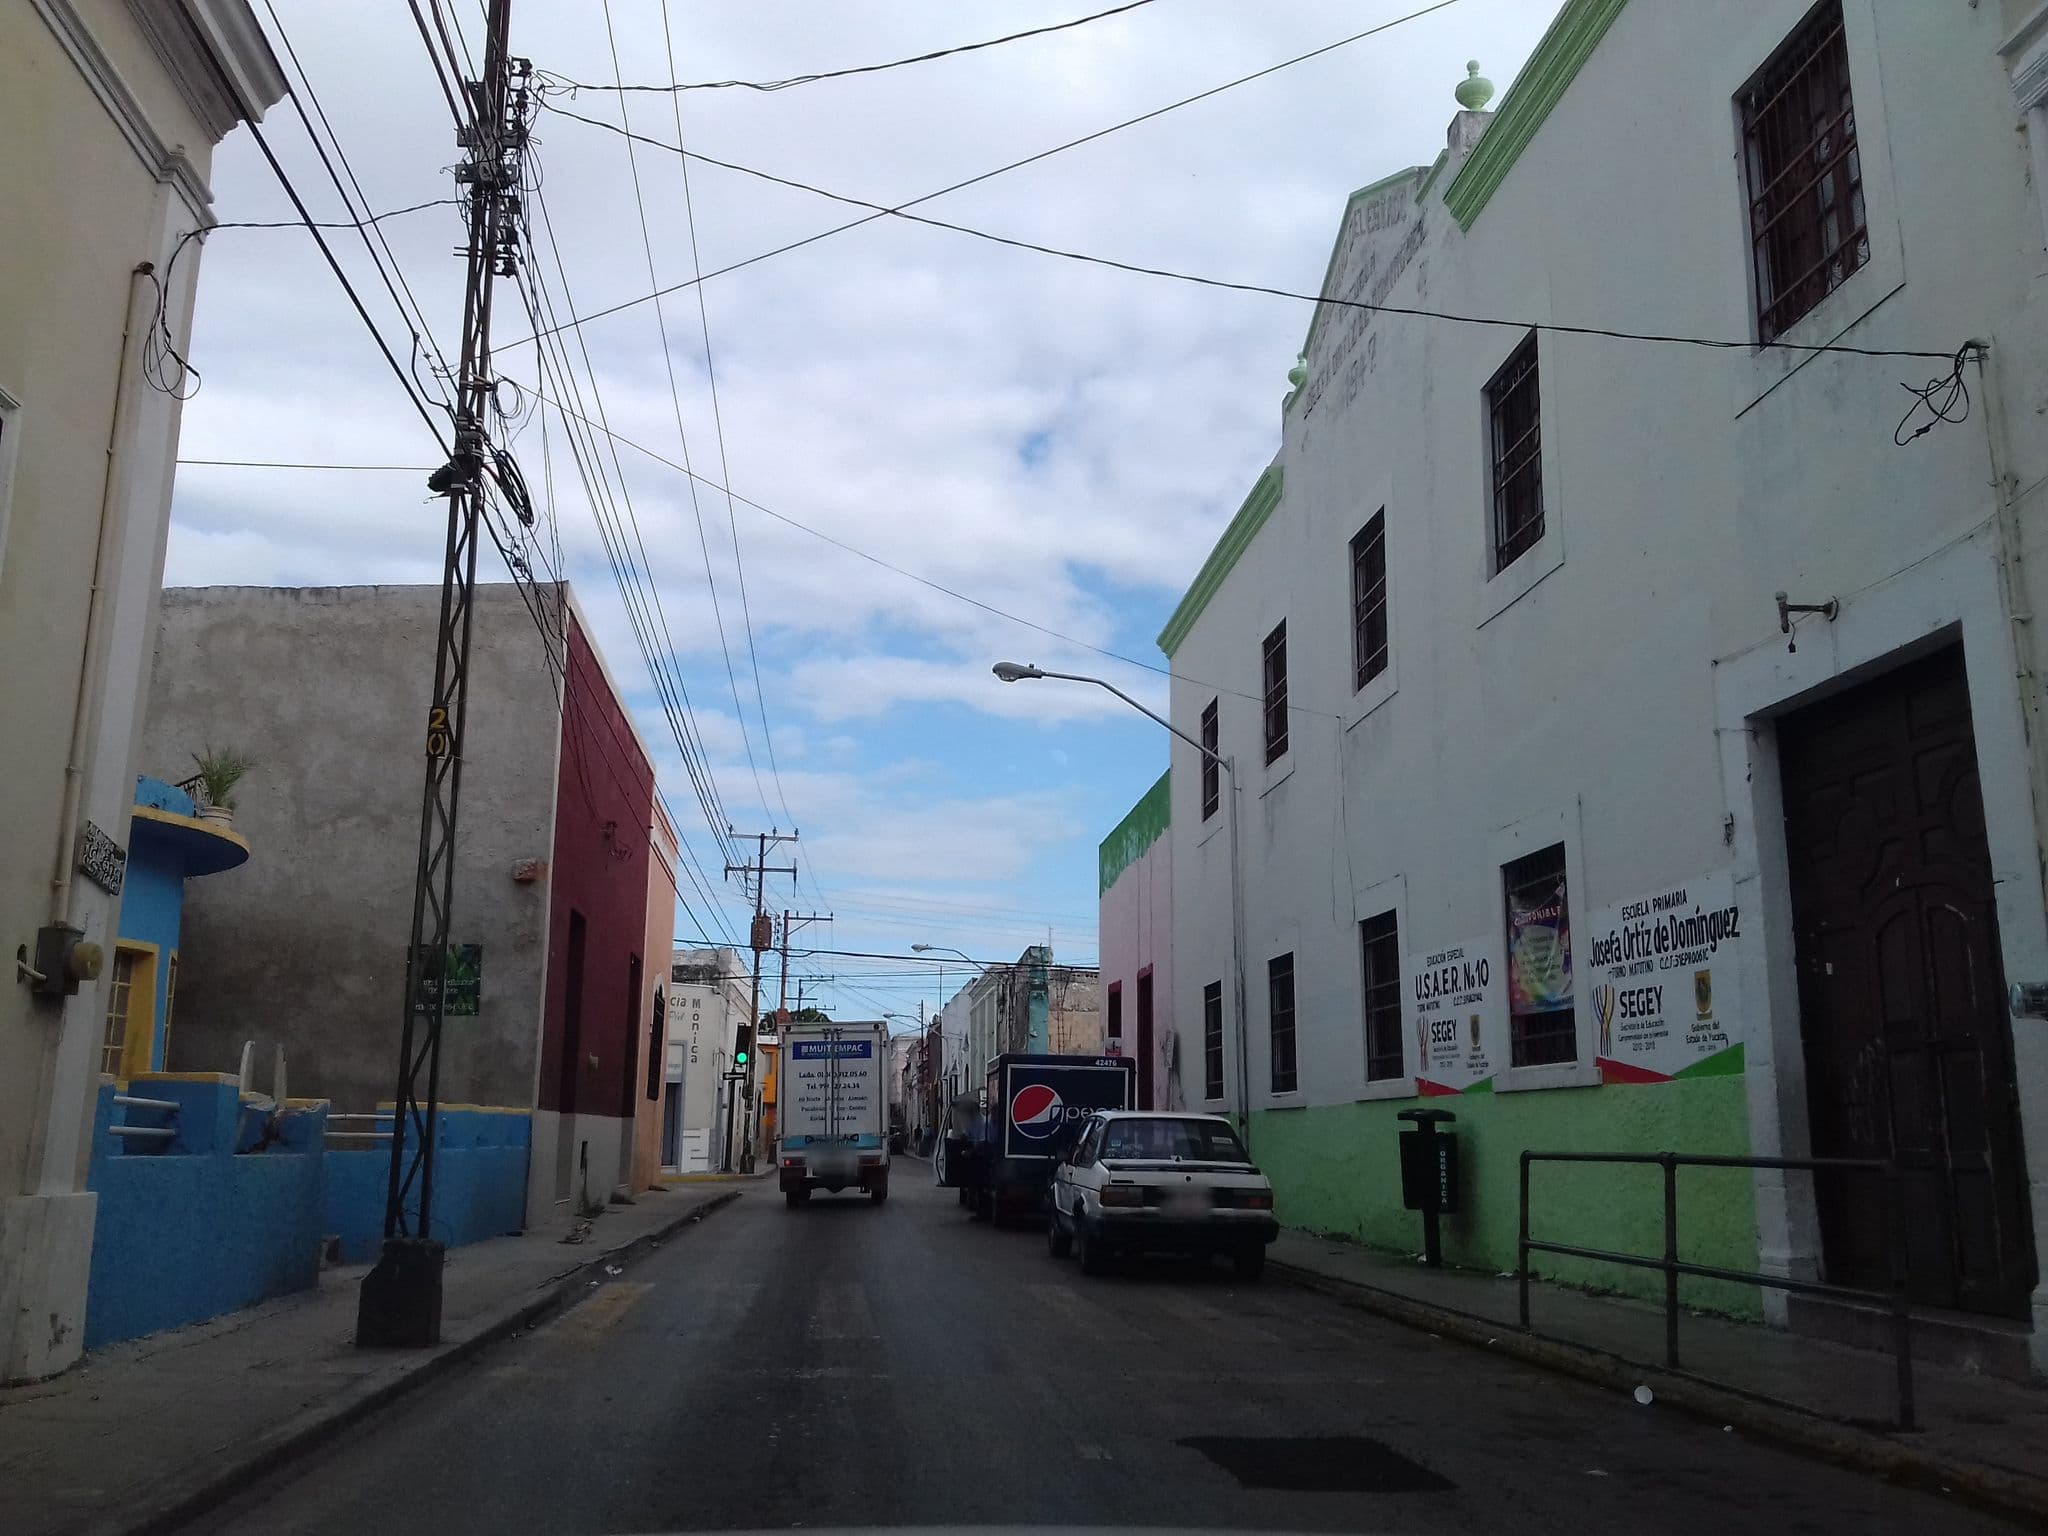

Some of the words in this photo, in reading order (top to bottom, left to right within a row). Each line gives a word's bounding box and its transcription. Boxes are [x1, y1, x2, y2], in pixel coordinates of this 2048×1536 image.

[1622, 900, 1650, 921] ESCUELA
[1652, 889, 1688, 913] PRIMARIA
[1590, 930, 1622, 968] Josefa
[1623, 920, 1652, 961] Ortíz
[1654, 917, 1669, 954] de
[1669, 905, 1740, 953] Domínguez
[1619, 985, 1663, 1019] SEGEY
[1431, 1019, 1457, 1043] SEGEY
